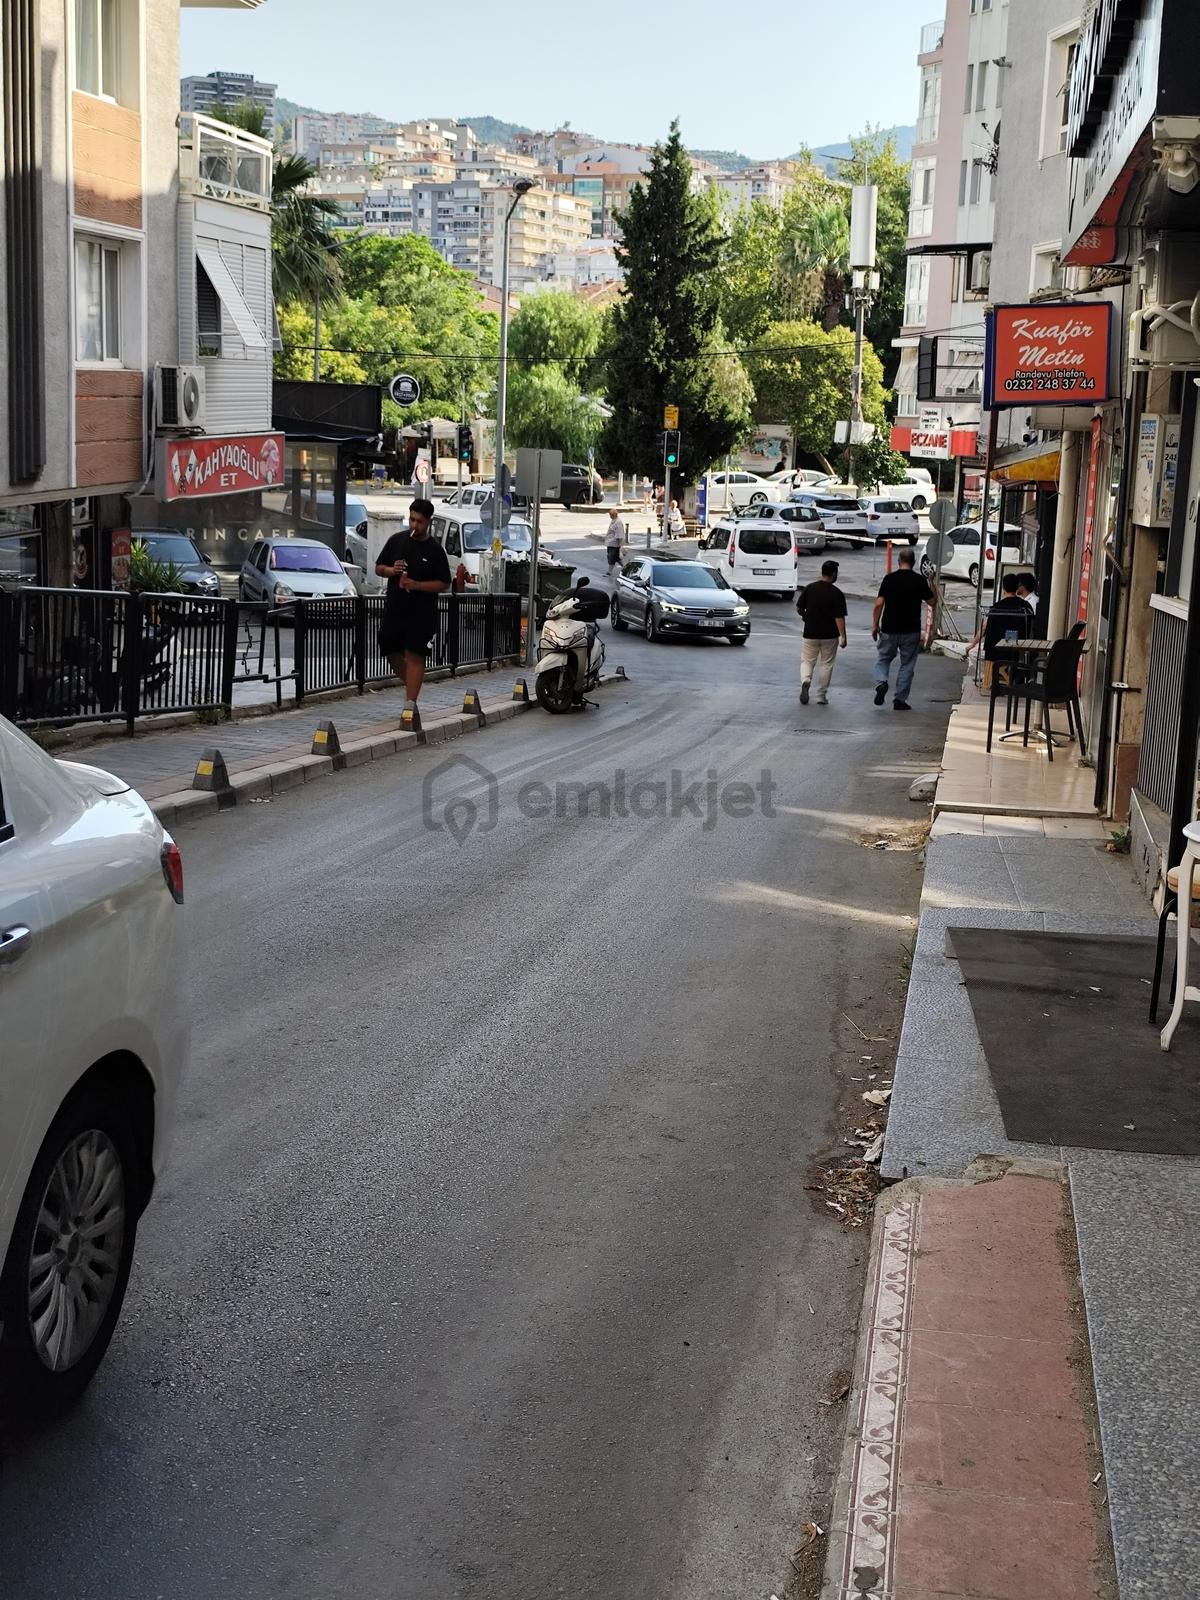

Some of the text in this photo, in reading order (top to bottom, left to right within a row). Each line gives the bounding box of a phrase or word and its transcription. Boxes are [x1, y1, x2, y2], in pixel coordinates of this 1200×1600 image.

[1012, 319, 1094, 345] Kuaför
[1019, 345, 1085, 366] Metin
[1016, 369, 1085, 379] Randevu Telefon
[1005, 379, 1095, 390] 0232 248 37 44
[911, 433, 947, 449] ECZANE
[194, 444, 260, 489] KAHYAOĞLU
[220, 472, 238, 486] ET
